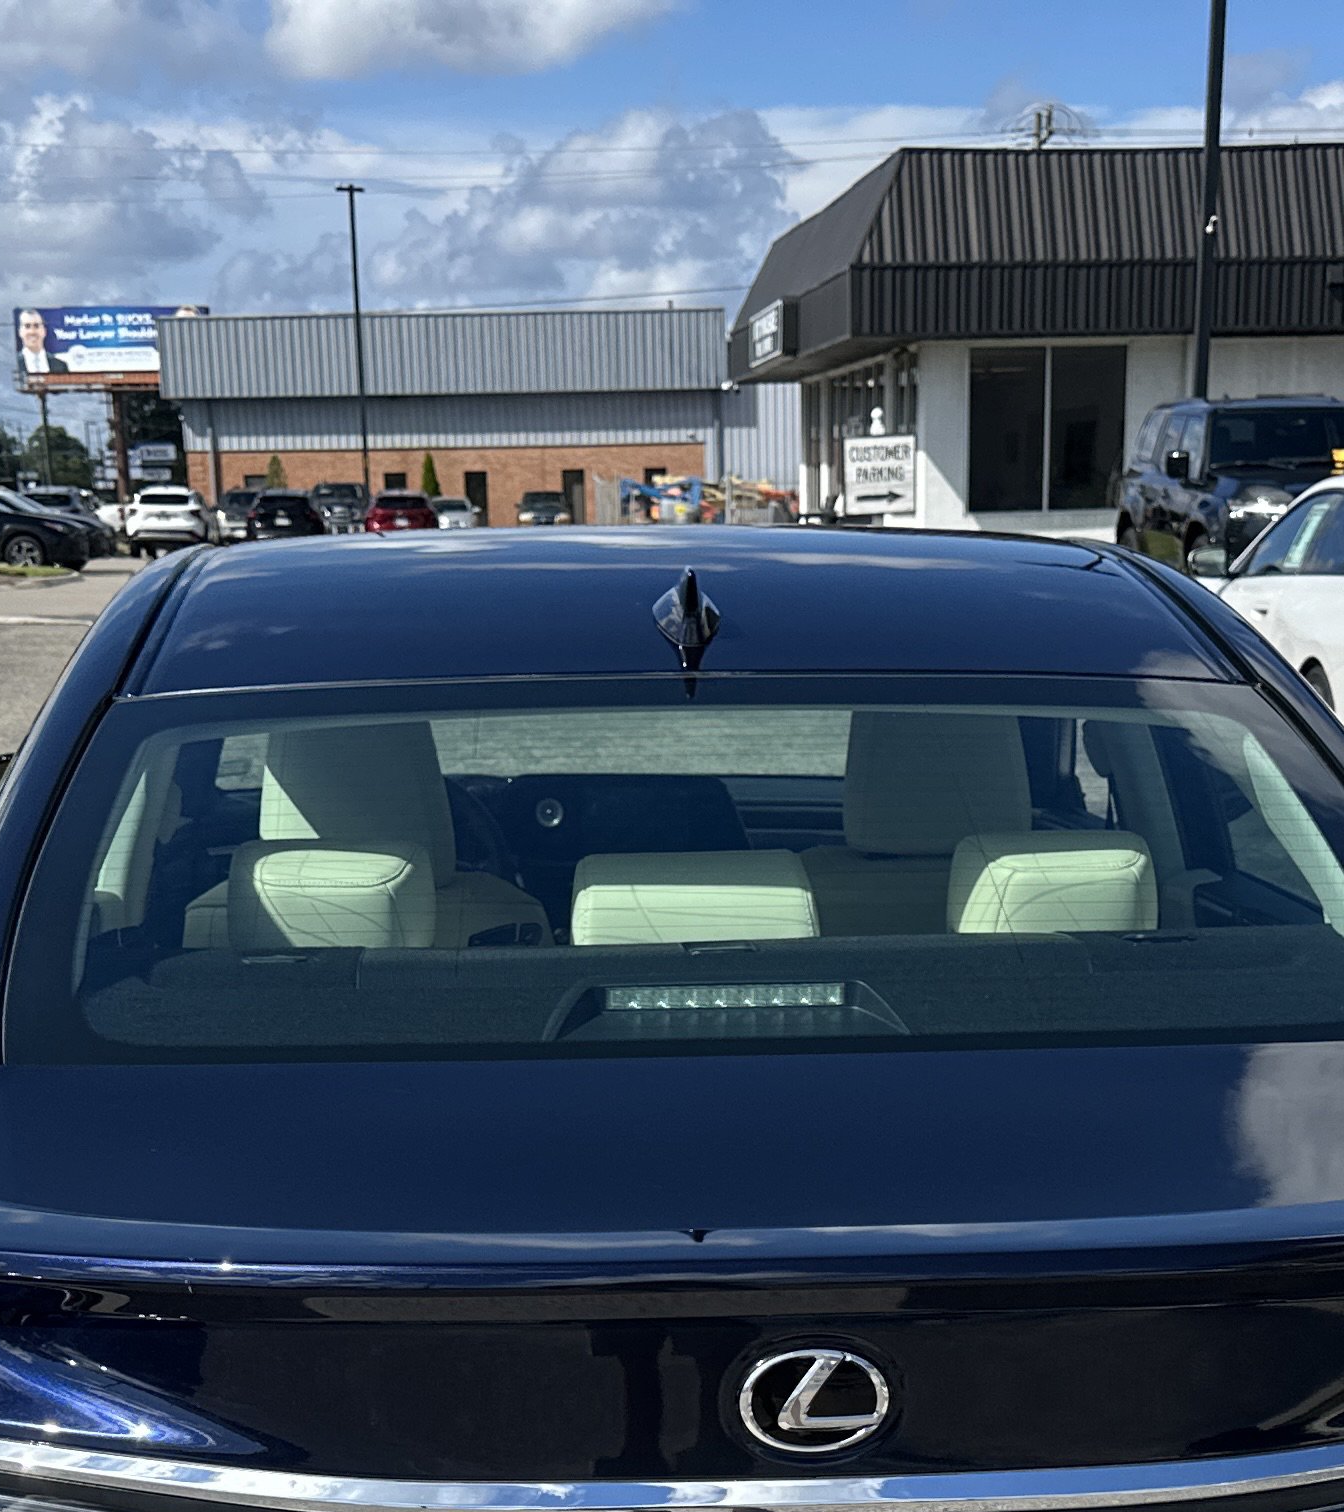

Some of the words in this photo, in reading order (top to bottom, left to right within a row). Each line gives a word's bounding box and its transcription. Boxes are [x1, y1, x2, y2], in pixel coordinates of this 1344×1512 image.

[63, 314, 100, 326] Market
[54, 328, 77, 340] Your
[78, 328, 115, 341] Lawyer
[849, 444, 911, 463] CUSTOMER
[856, 466, 905, 483] PARKING
